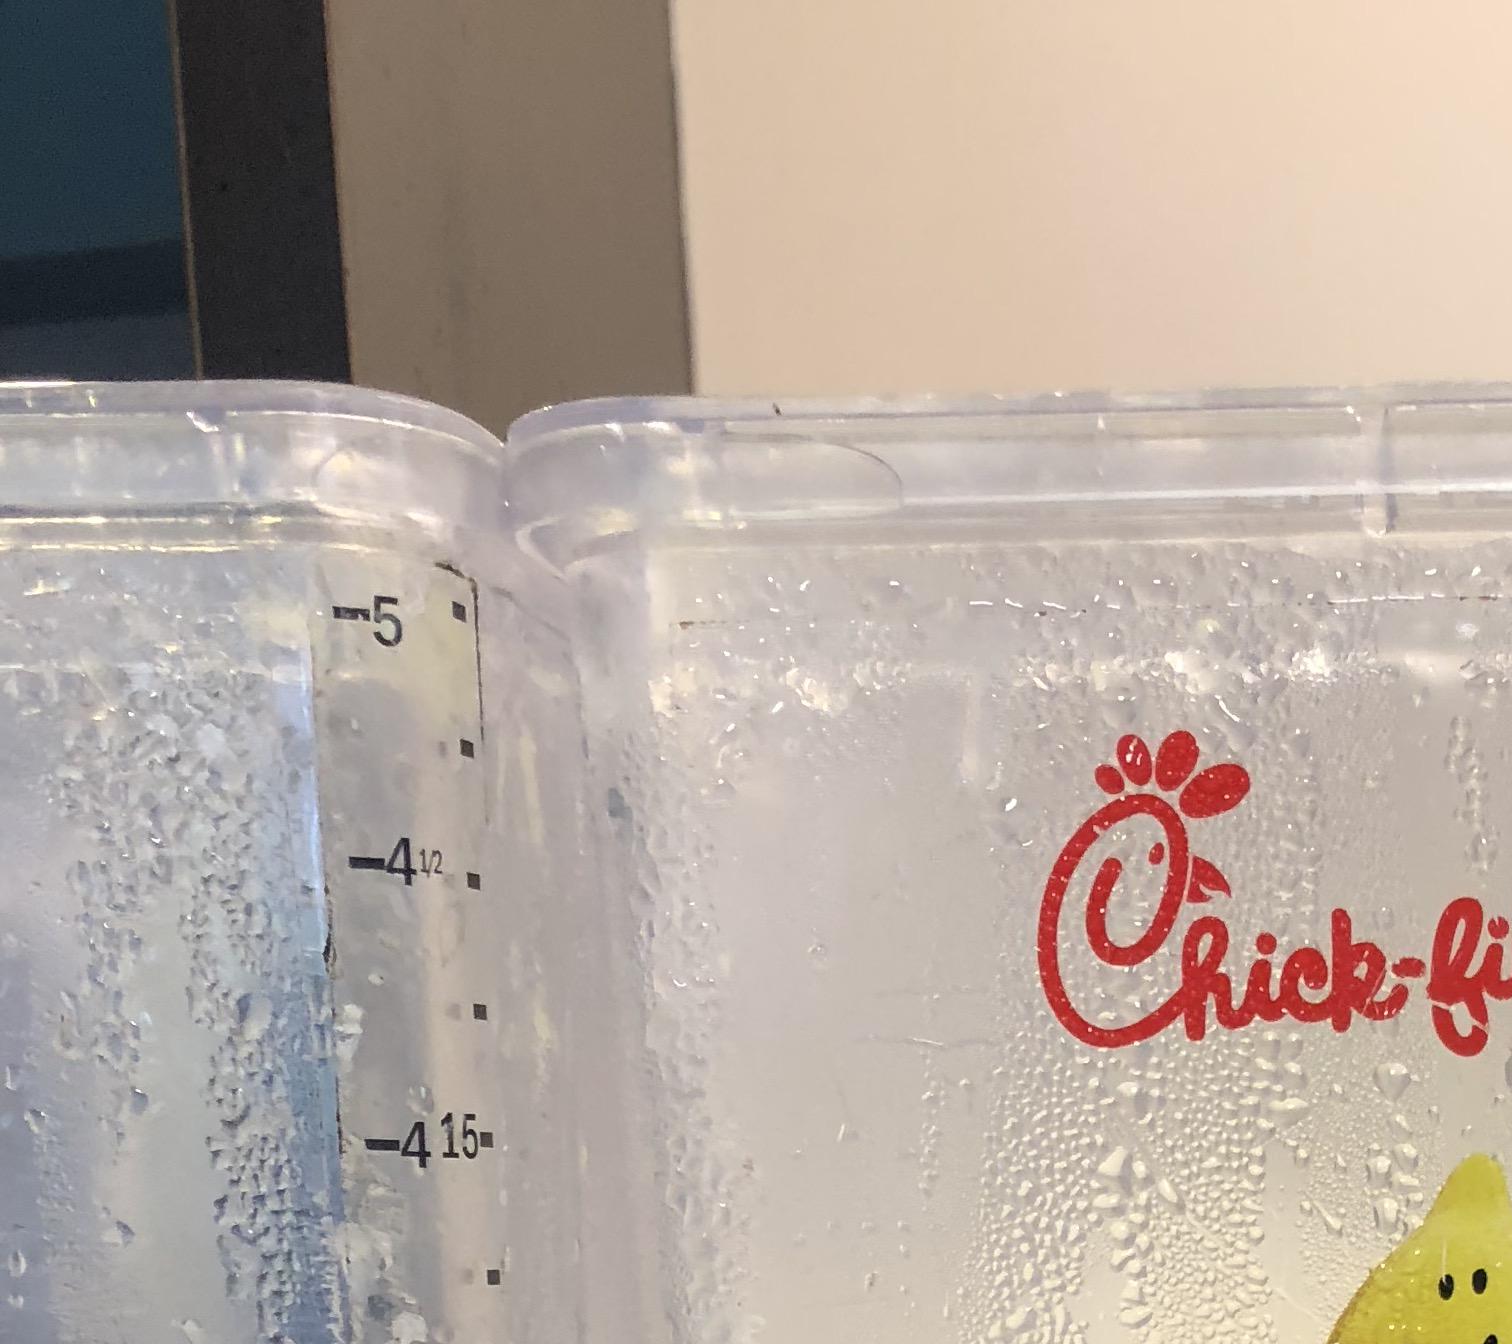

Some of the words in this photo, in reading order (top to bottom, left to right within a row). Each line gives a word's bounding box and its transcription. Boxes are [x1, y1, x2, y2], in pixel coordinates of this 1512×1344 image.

[372, 595, 404, 648] 5
[399, 1120, 432, 1170] 4
[440, 1111, 480, 1161] 15
